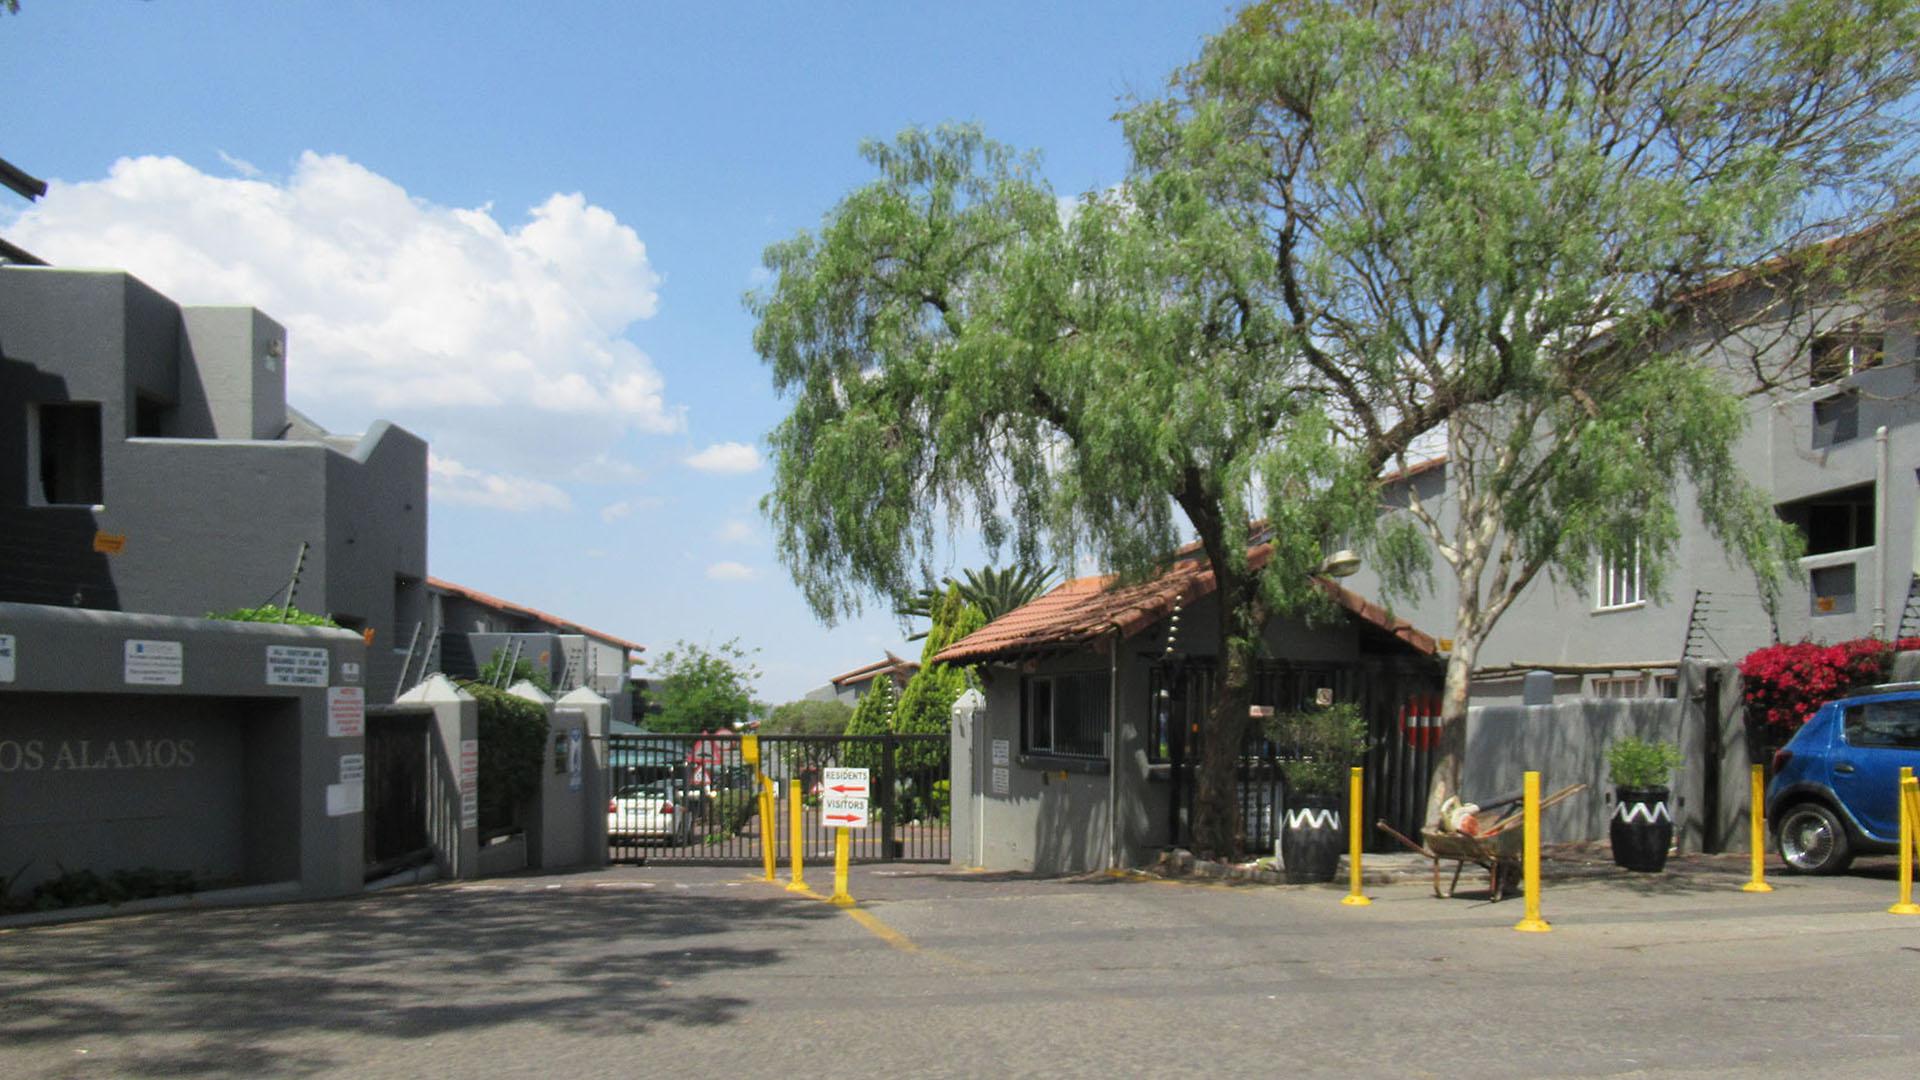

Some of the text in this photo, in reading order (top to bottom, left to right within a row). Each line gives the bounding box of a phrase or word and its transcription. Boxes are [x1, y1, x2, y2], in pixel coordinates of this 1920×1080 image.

[54, 738, 196, 770] ALAMOS
[826, 771, 867, 780] RESIDENTS
[827, 799, 864, 809] VISITORS
